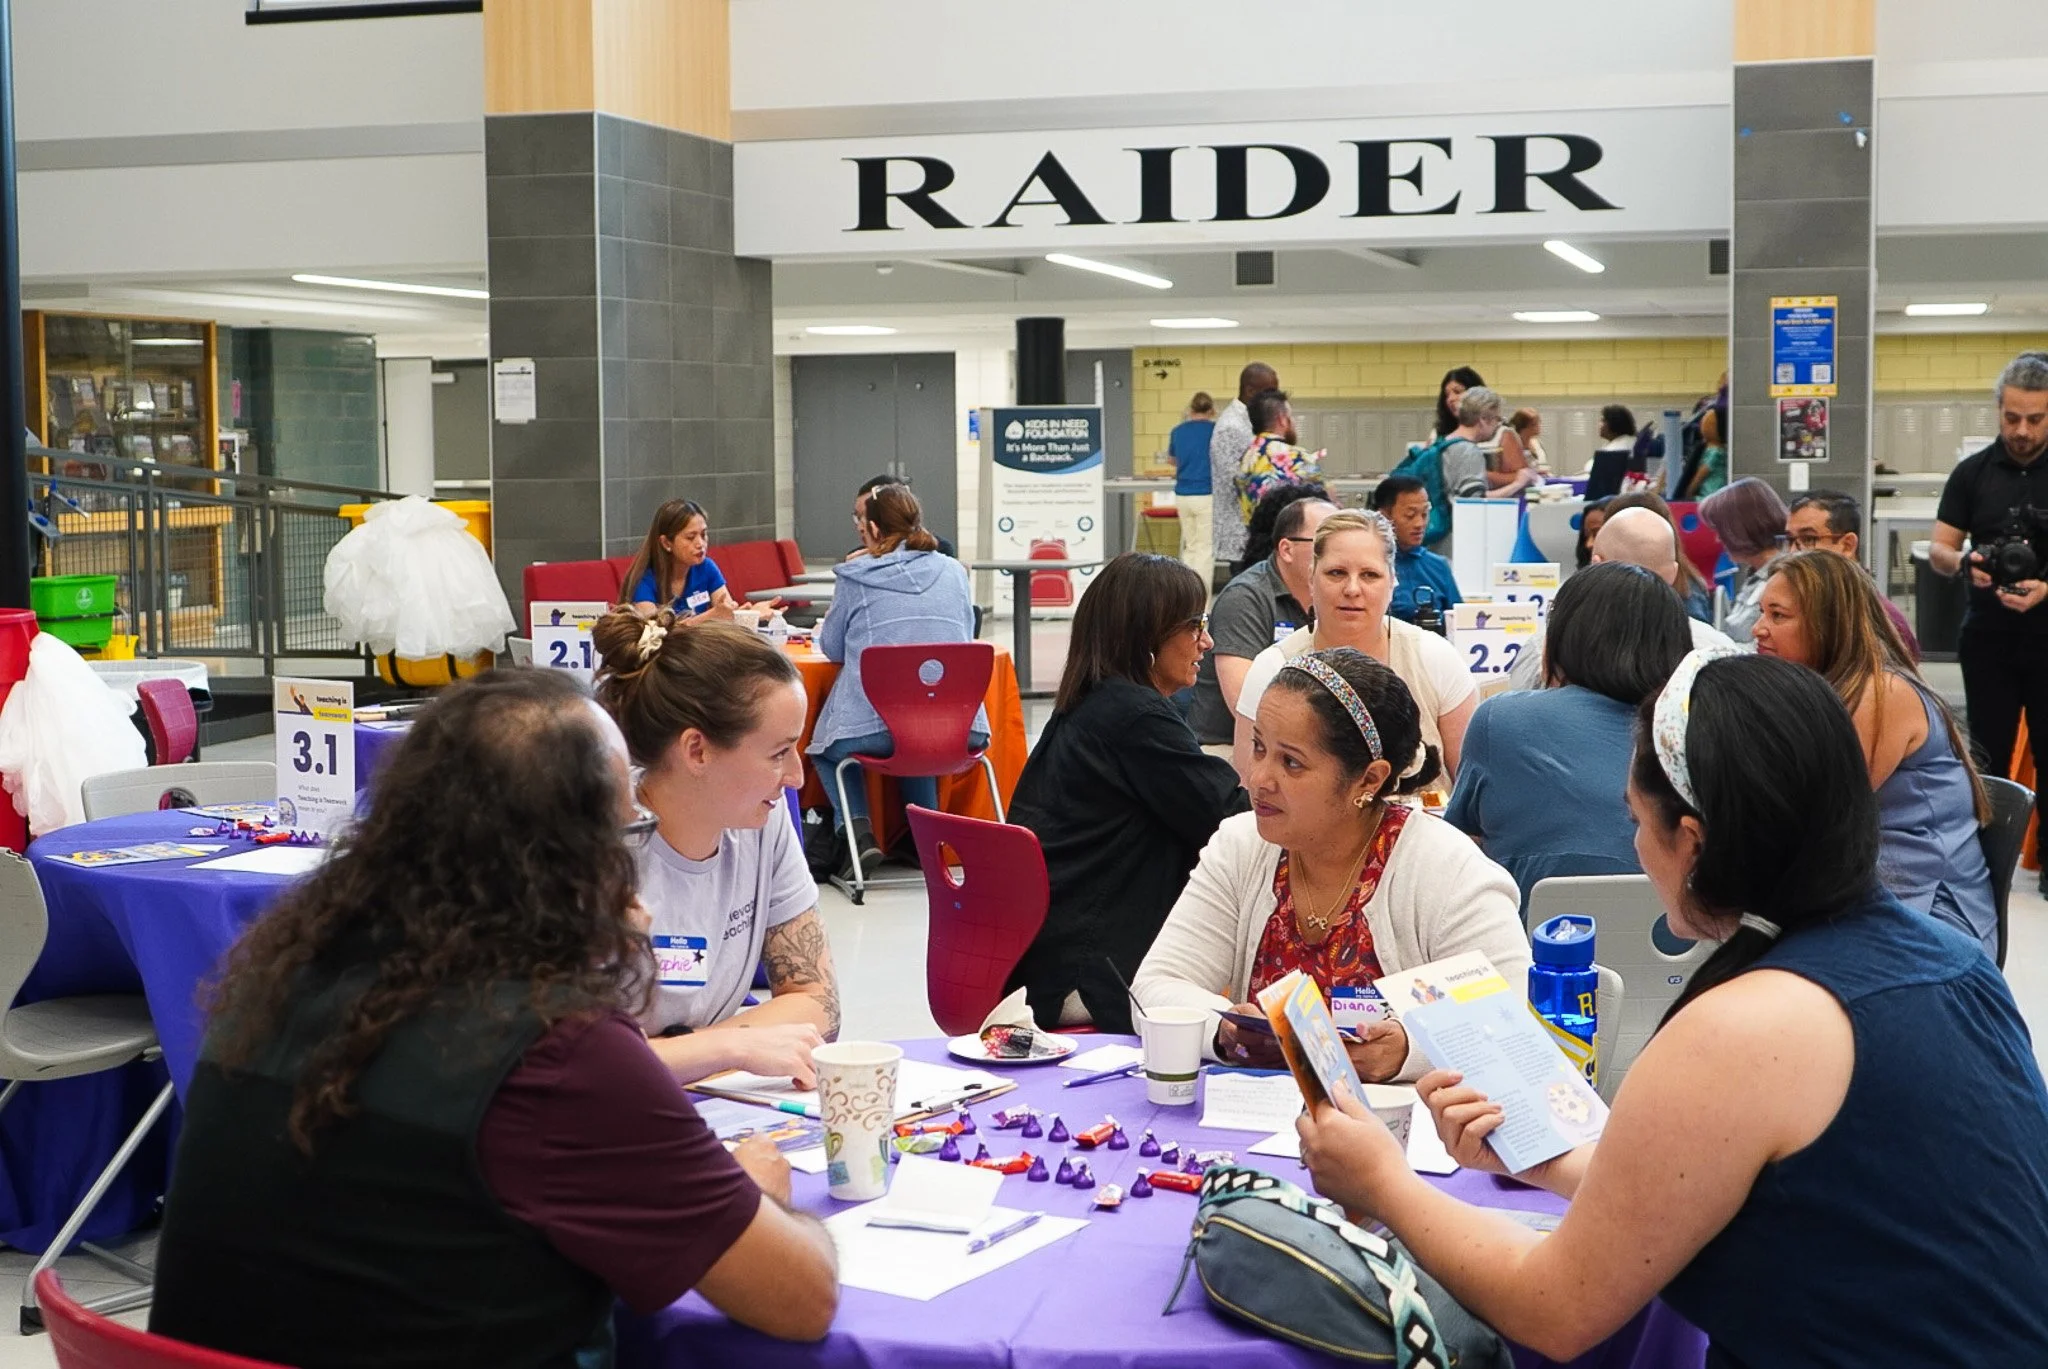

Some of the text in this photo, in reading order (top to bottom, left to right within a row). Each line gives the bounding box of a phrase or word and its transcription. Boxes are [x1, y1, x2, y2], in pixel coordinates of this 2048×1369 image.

[842, 134, 1625, 232] RAIDER
[1024, 419, 1089, 429] KIDS IN NEED
[1024, 429, 1089, 439] FOUNDATION
[1006, 442, 1090, 452] It's More Than Just
[550, 641, 592, 668] 2.1
[316, 696, 341, 706] teaching
[293, 731, 337, 775] 3.1
[655, 954, 692, 977] ophie
[1355, 986, 1376, 995] Hello
[1333, 1000, 1377, 1013] Diana
